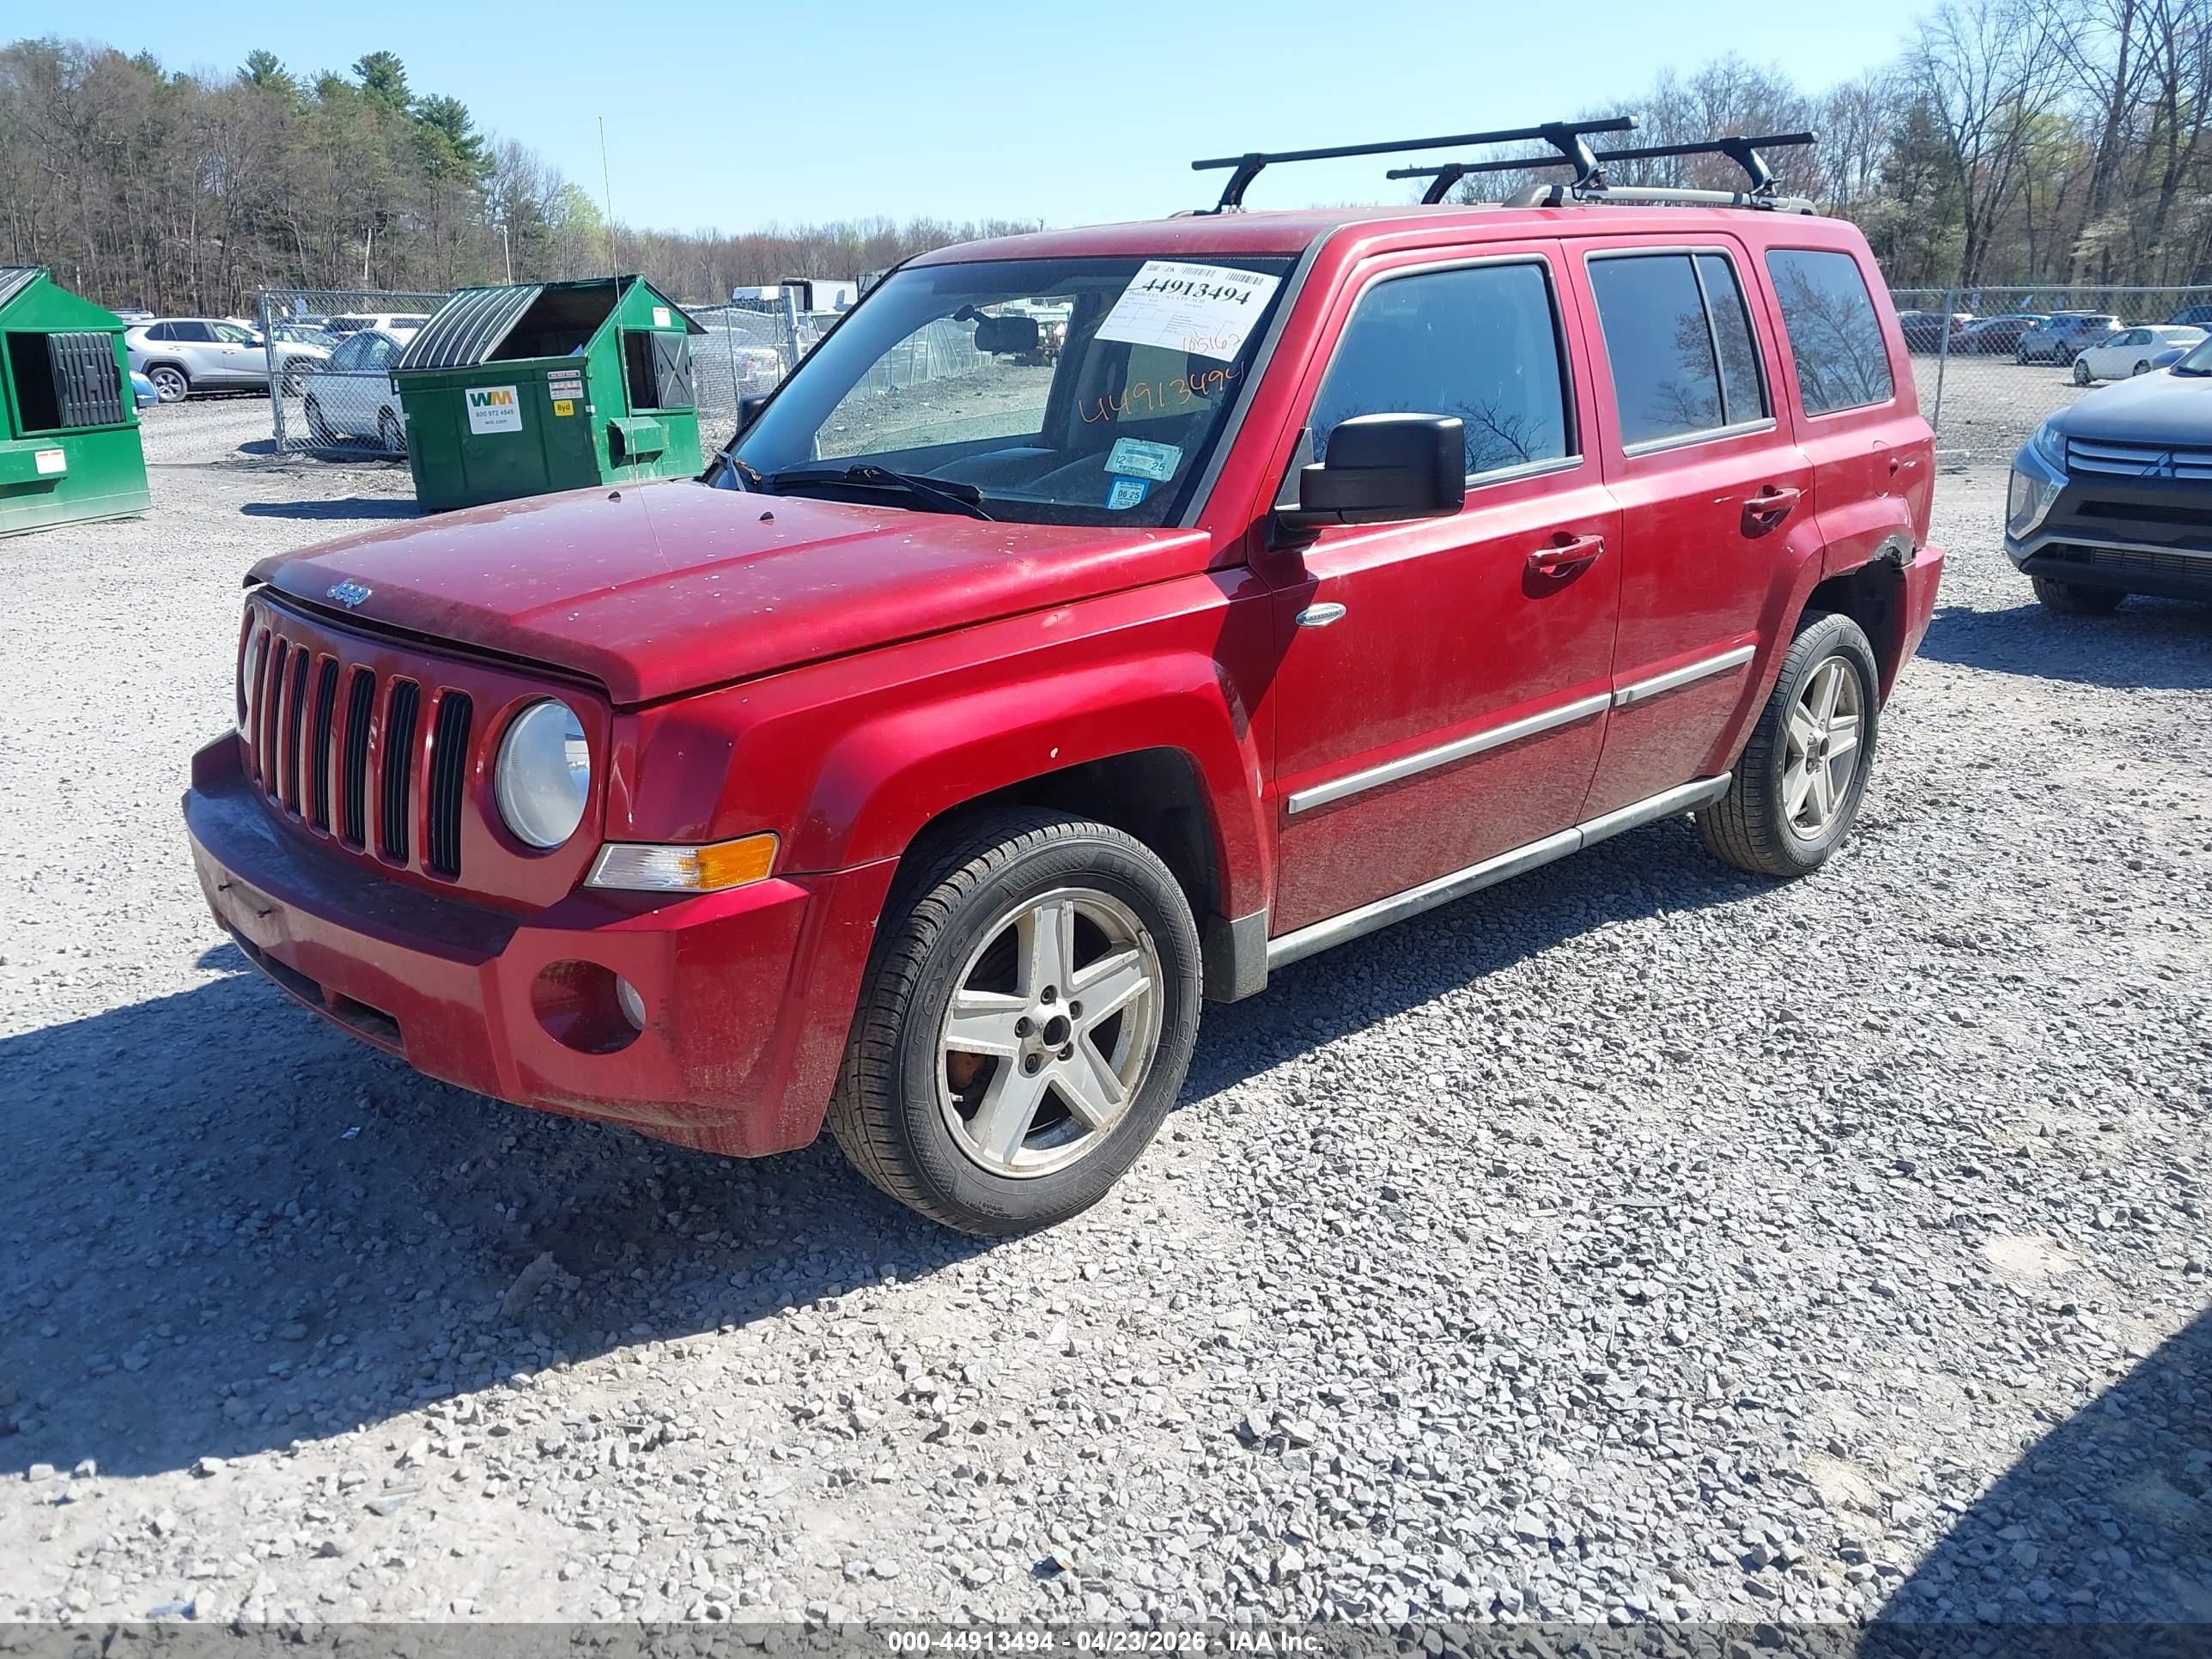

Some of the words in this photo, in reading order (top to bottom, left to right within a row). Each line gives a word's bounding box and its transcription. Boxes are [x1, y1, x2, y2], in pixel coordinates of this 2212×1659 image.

[1142, 277, 1251, 305] 44913494
[470, 390, 514, 408] WM
[1078, 360, 1245, 423] 44913494
[1115, 455, 1127, 465] 12
[1151, 461, 1166, 472] 25
[326, 577, 372, 609] Jeep
